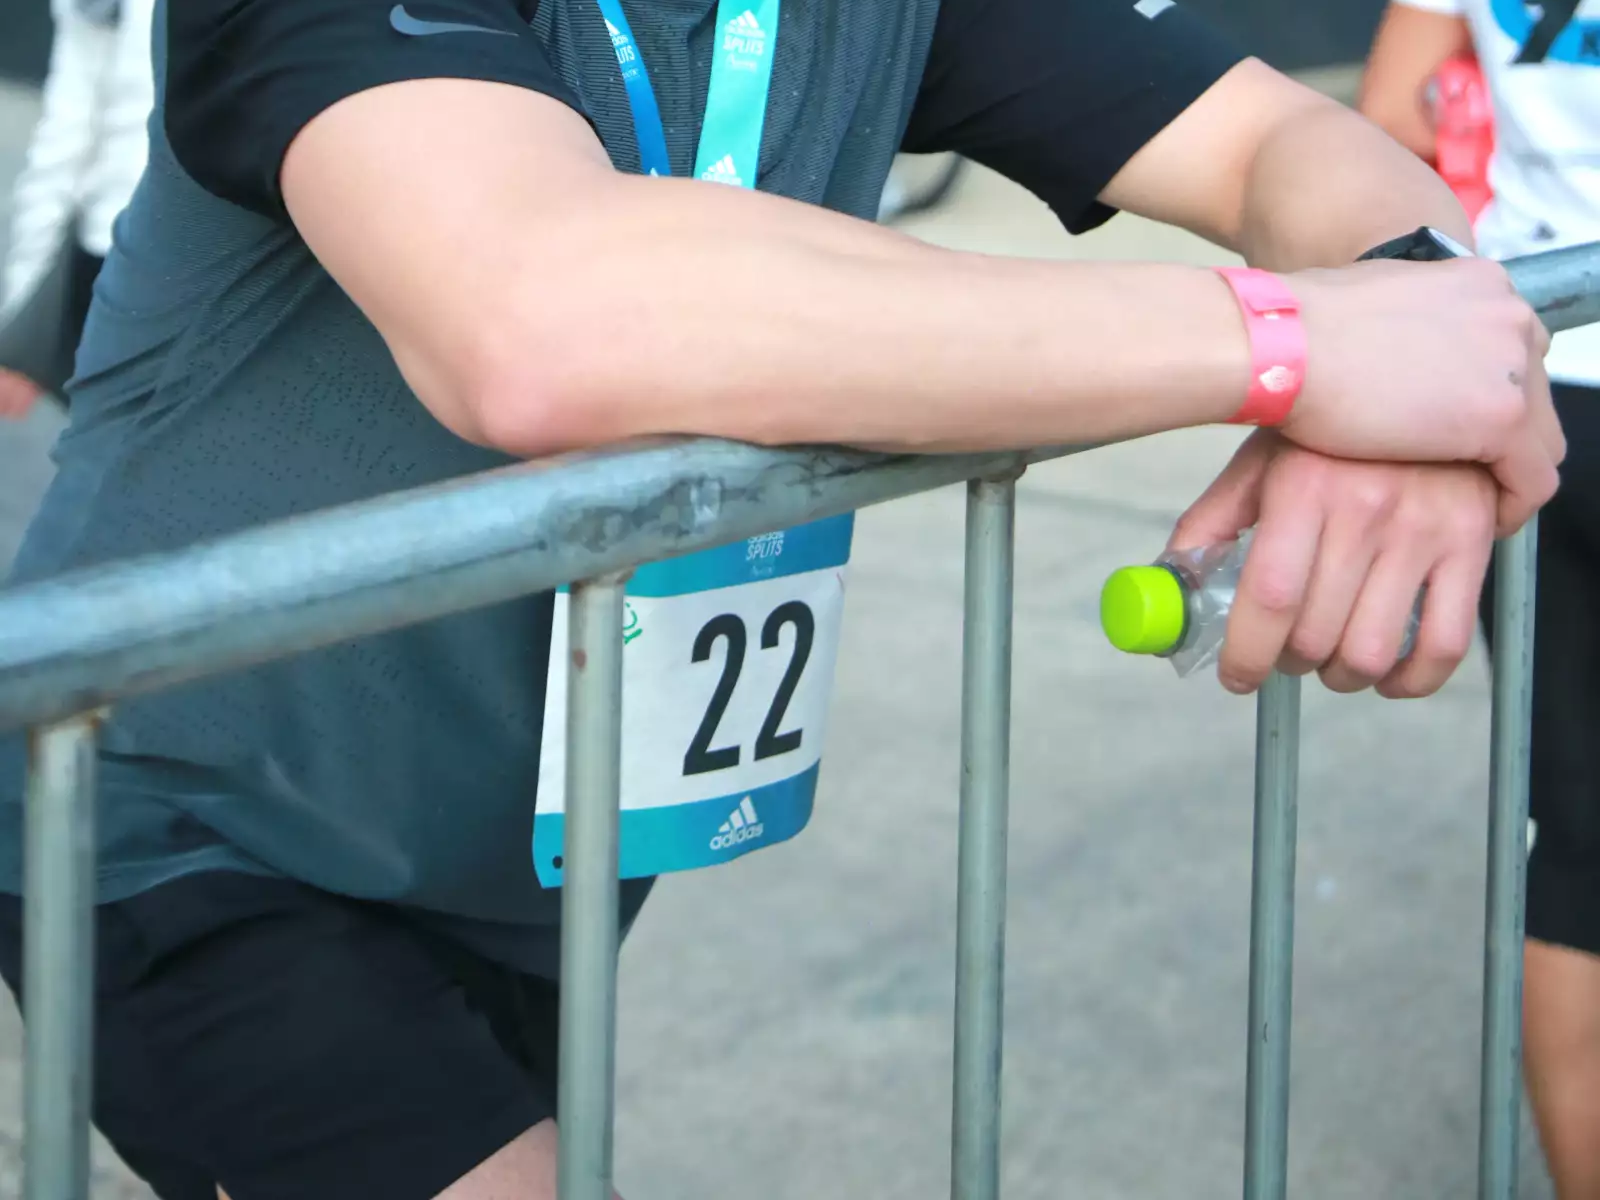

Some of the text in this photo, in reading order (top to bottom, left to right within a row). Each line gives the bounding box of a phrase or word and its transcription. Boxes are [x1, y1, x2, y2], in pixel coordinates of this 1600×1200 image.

[745, 540, 784, 561] SPLITS
[682, 600, 815, 776] 22
[709, 823, 764, 850] adidas
